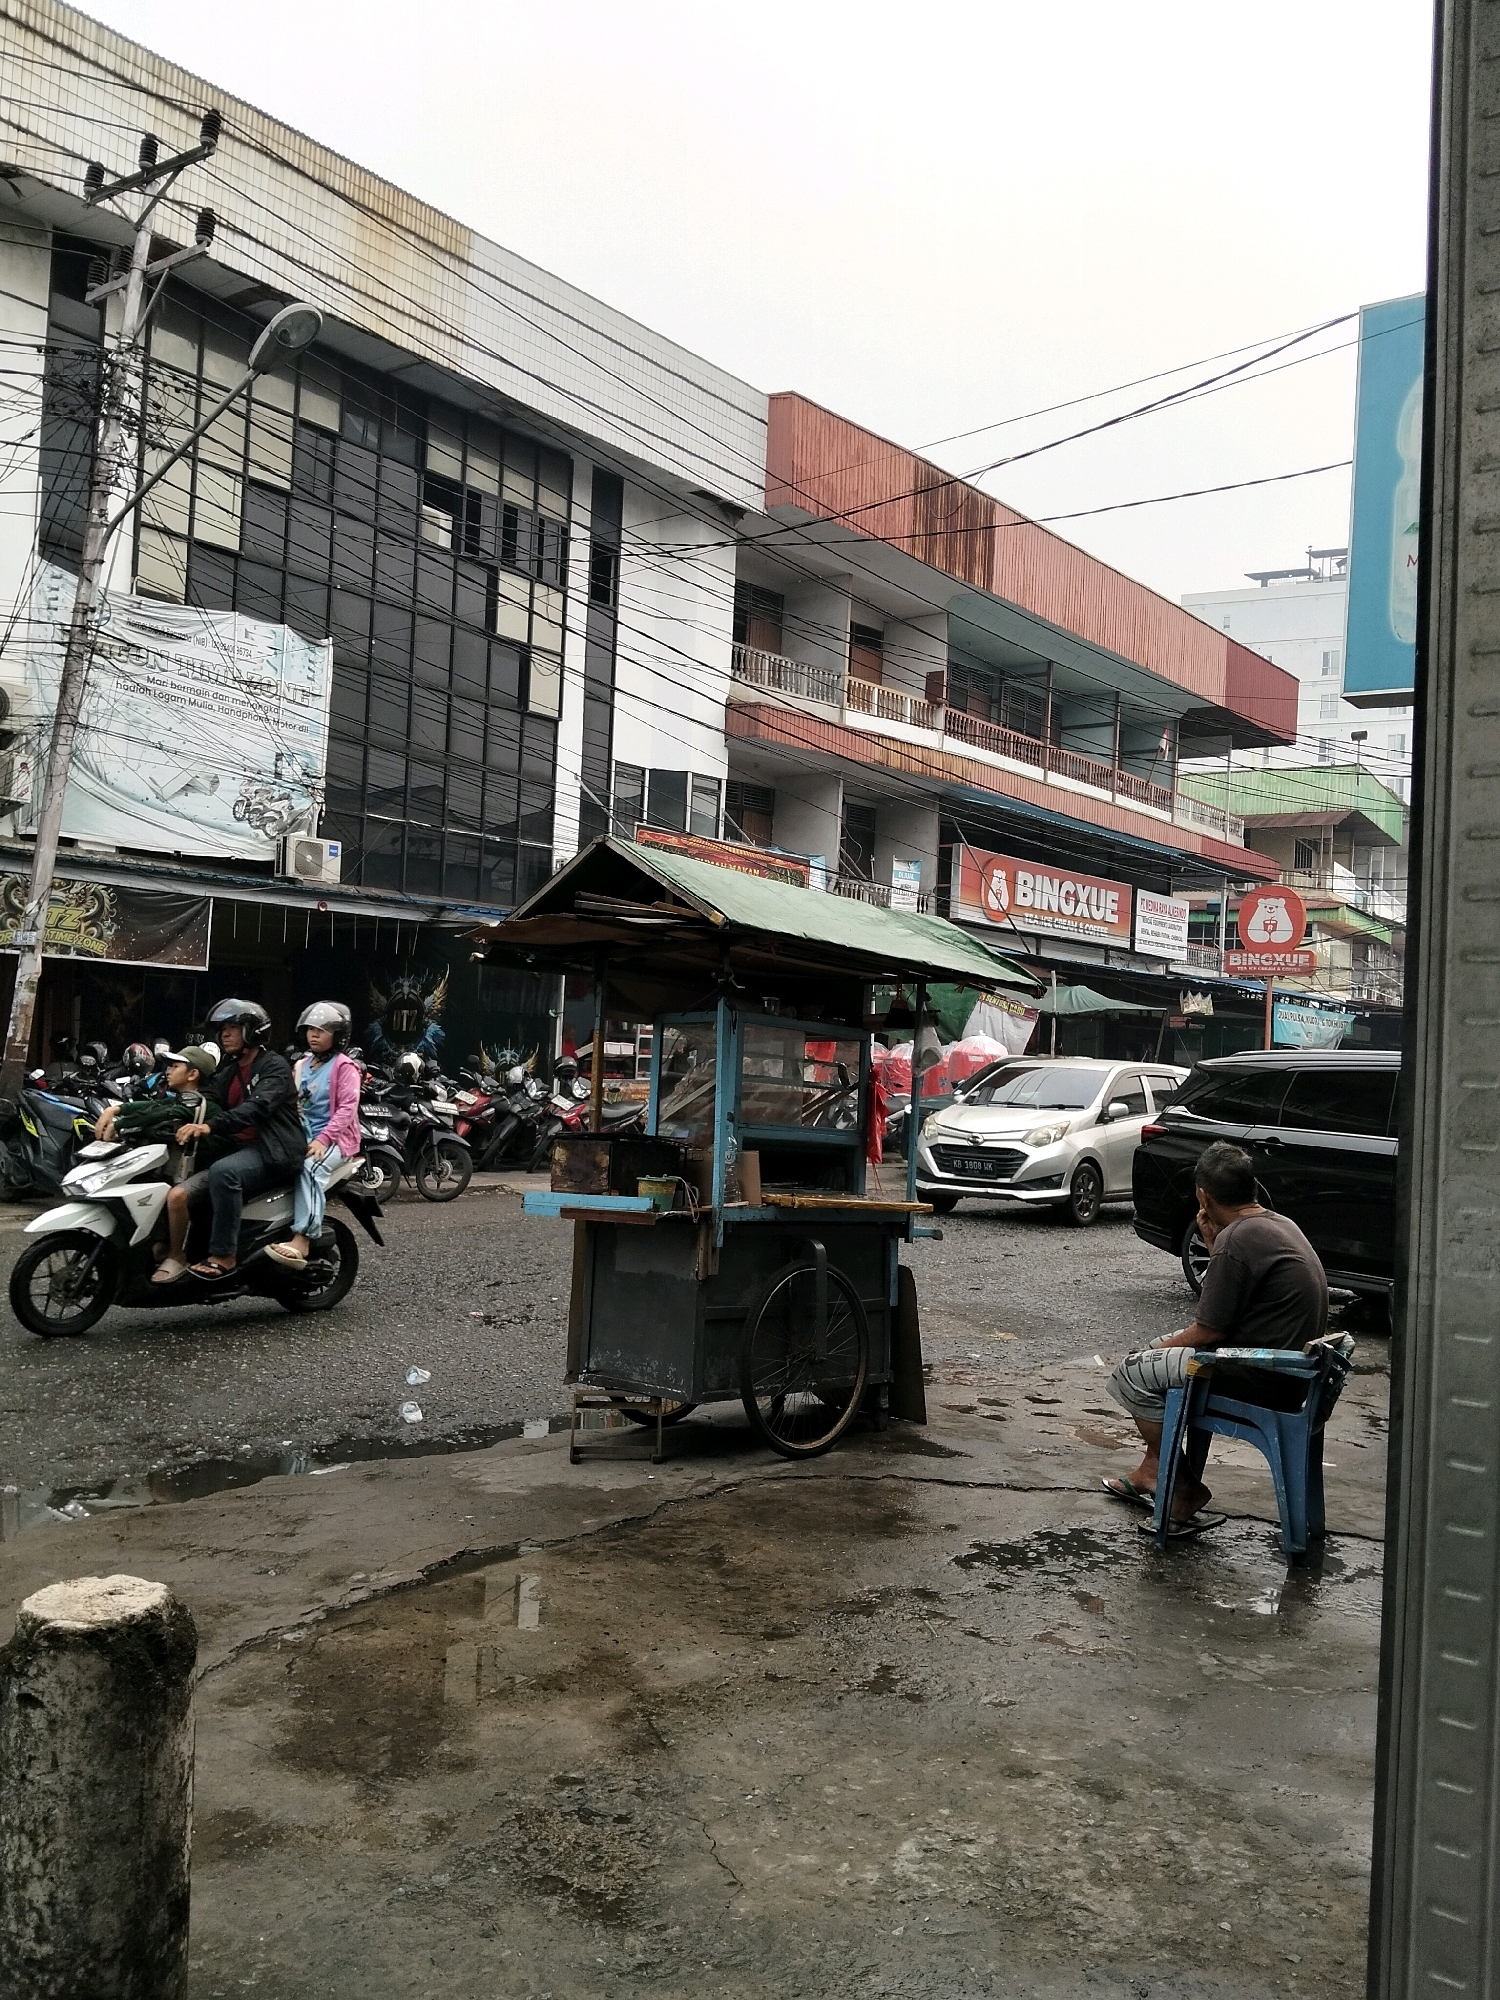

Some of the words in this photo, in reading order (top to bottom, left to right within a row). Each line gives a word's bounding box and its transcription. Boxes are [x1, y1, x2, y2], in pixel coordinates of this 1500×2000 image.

[146, 675, 169, 687] Mari
[170, 682, 213, 700] bermain
[212, 691, 230, 703] dan
[116, 681, 152, 697] hadiah
[153, 690, 187, 705] Logam
[272, 717, 297, 731] Motor
[1014, 870, 1119, 924] BINGXUE
[1054, 917, 1078, 932] CREAM
[1085, 923, 1109, 937] COFFEE
[48, 930, 77, 944] TIME
[75, 934, 106, 953] ZONE
[1229, 952, 1310, 967] BINGXUE
[953, 1159, 962, 1168] KB
